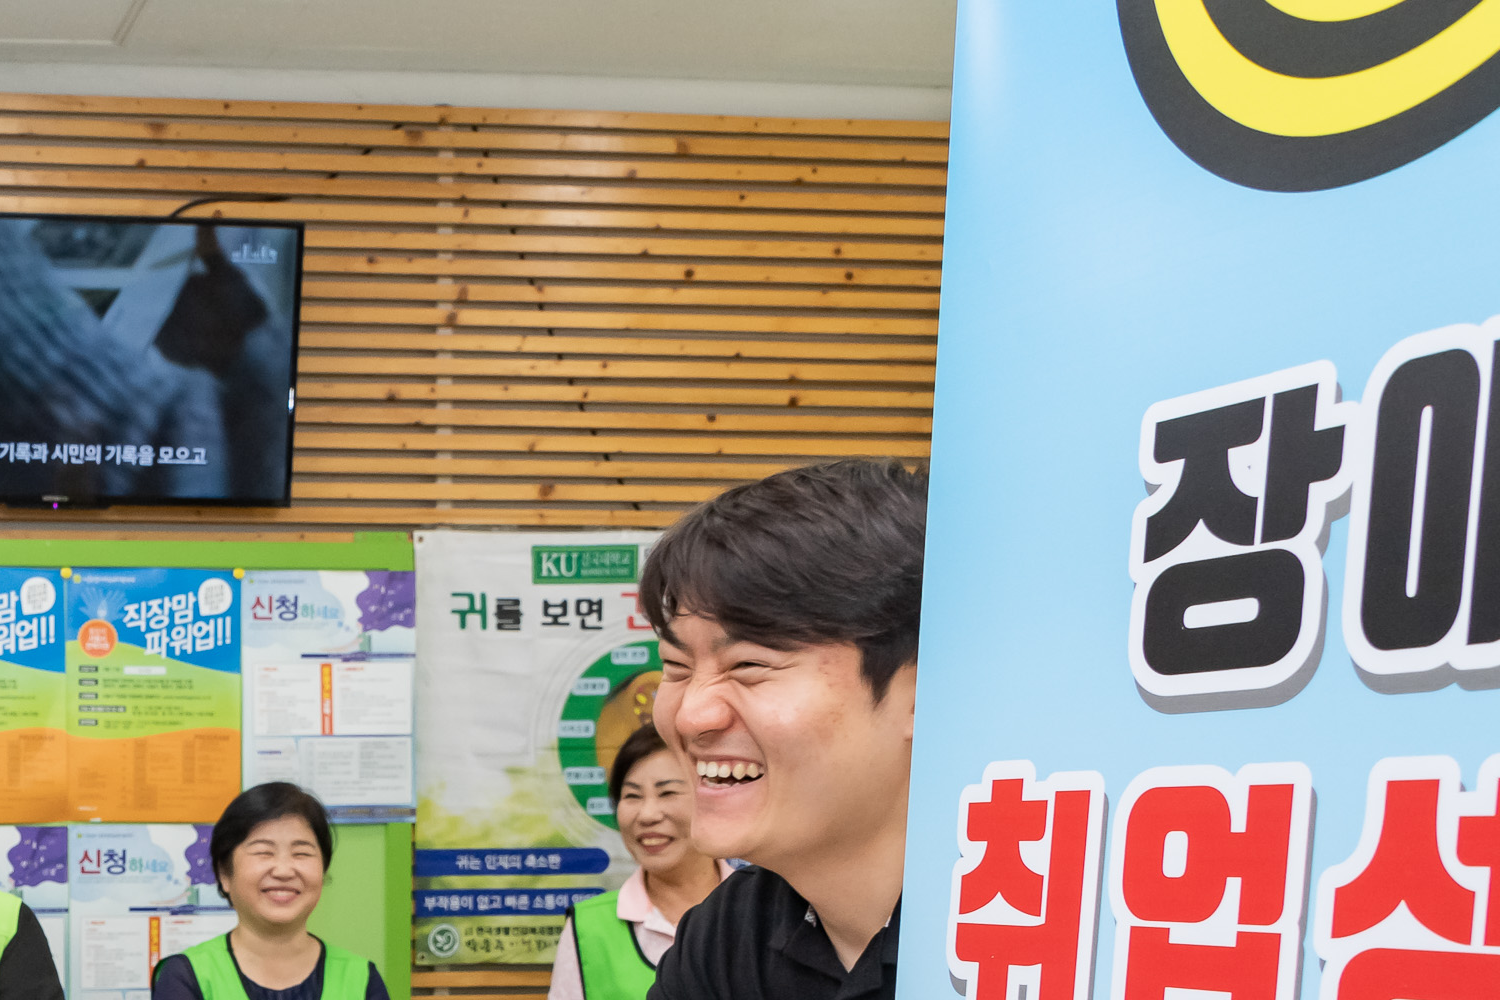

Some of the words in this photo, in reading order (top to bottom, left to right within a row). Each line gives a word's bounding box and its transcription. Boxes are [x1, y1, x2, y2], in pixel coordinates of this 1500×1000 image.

[51, 443, 102, 466] 시민의
[105, 444, 155, 467] 기록을
[157, 446, 208, 467] 모으고
[540, 551, 578, 577] KU
[122, 592, 197, 633] 직장맘
[450, 592, 523, 631] 귀를
[541, 598, 603, 631] 보면
[144, 616, 232, 659] 파워업!!
[455, 854, 482, 870] 귀는
[424, 895, 474, 912] 부작용이
[476, 894, 503, 911] 없고
[504, 894, 530, 911] 빠른
